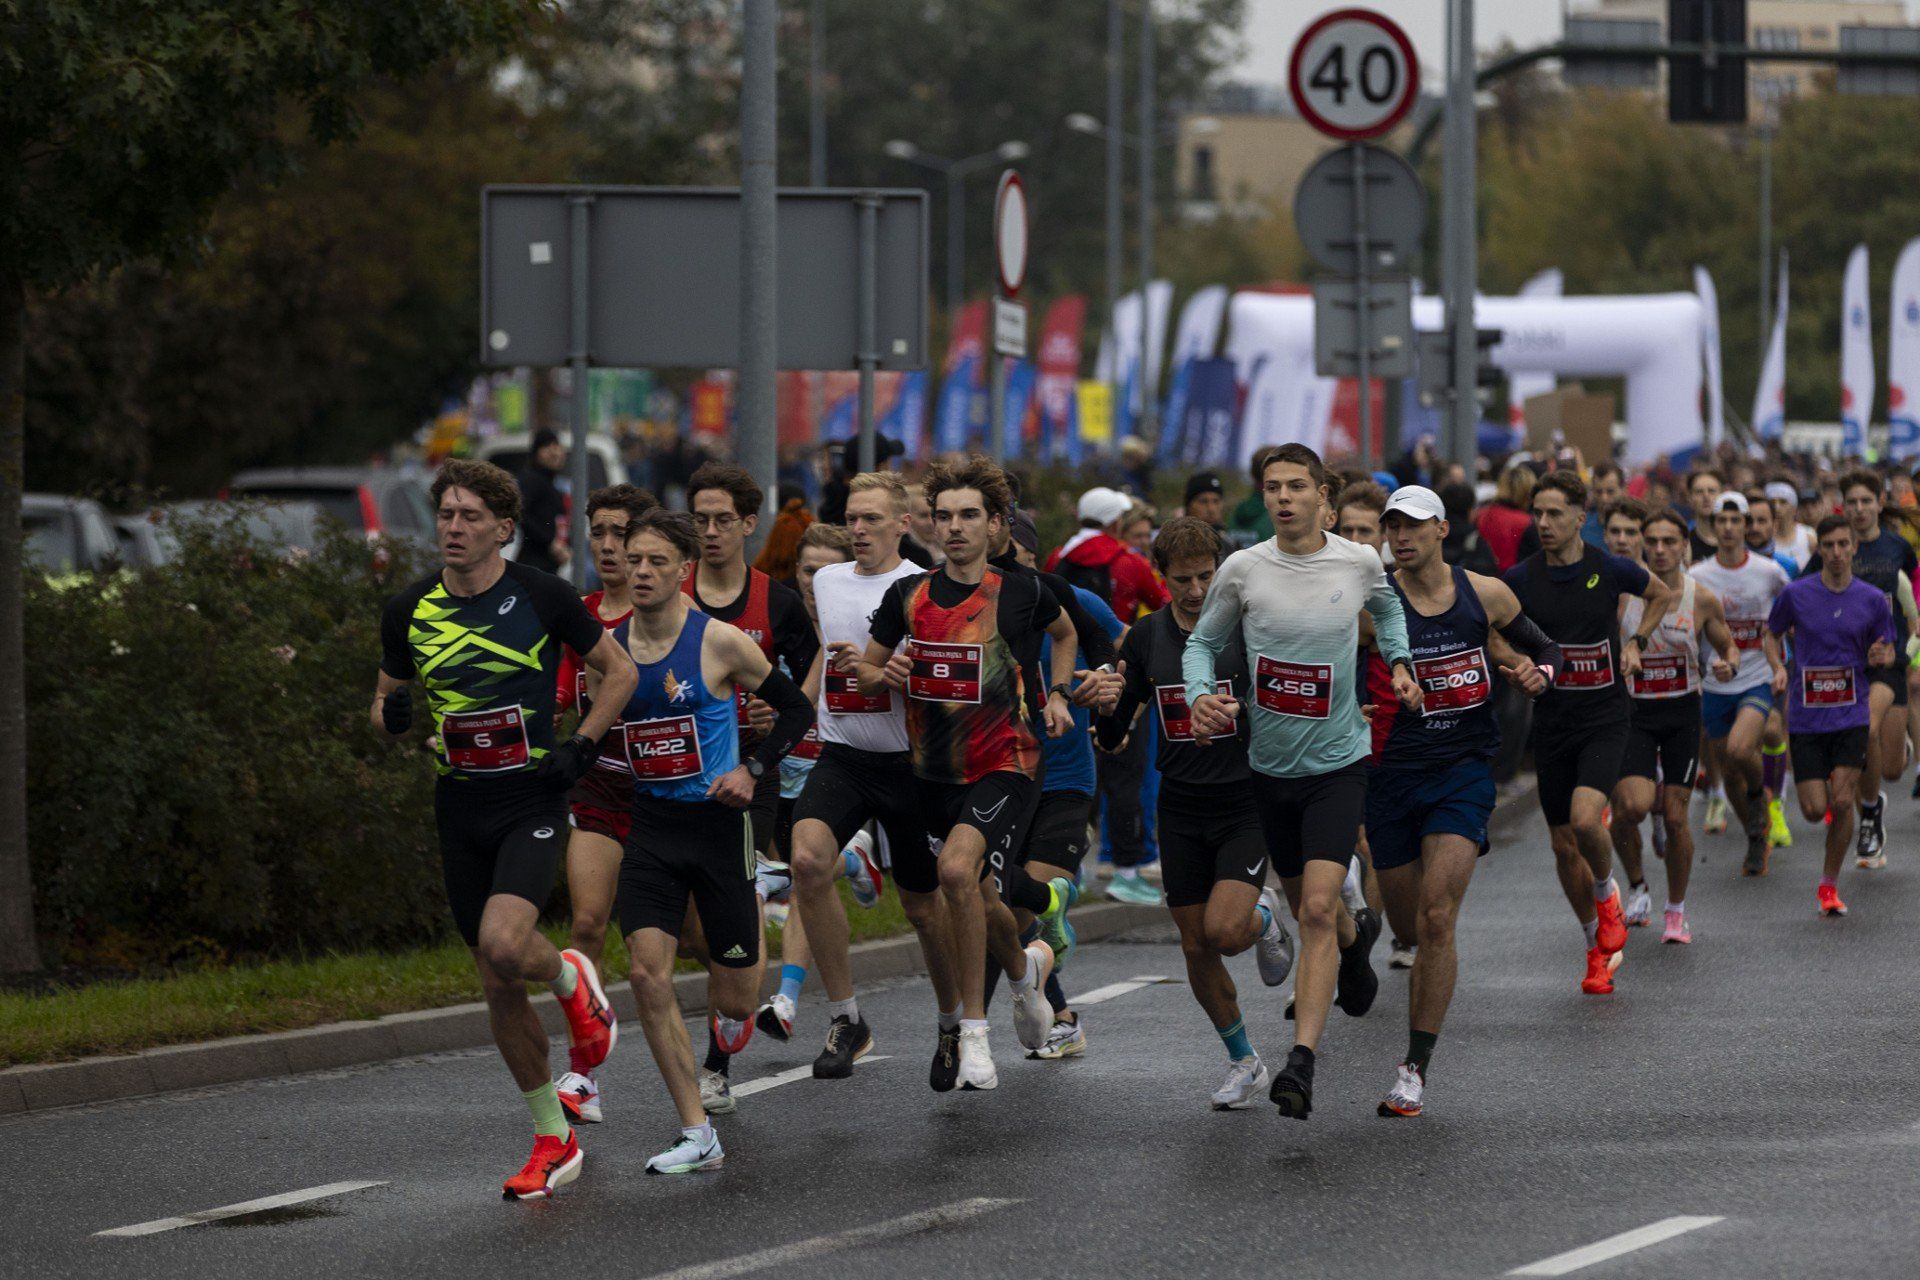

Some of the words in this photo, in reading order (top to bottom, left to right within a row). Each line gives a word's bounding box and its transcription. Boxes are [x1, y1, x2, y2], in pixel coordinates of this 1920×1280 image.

[1310, 44, 1397, 104] 40
[1411, 646, 1439, 655] Miłosz
[1440, 641, 1467, 652] Bielak
[933, 663, 949, 677] 8
[1571, 660, 1597, 672] 1111
[1267, 678, 1316, 696] 458
[1424, 669, 1479, 691] 1300
[1425, 718, 1460, 729] ŻARY
[474, 732, 492, 748] 6
[803, 728, 825, 743] 2
[634, 738, 686, 757] 1422
